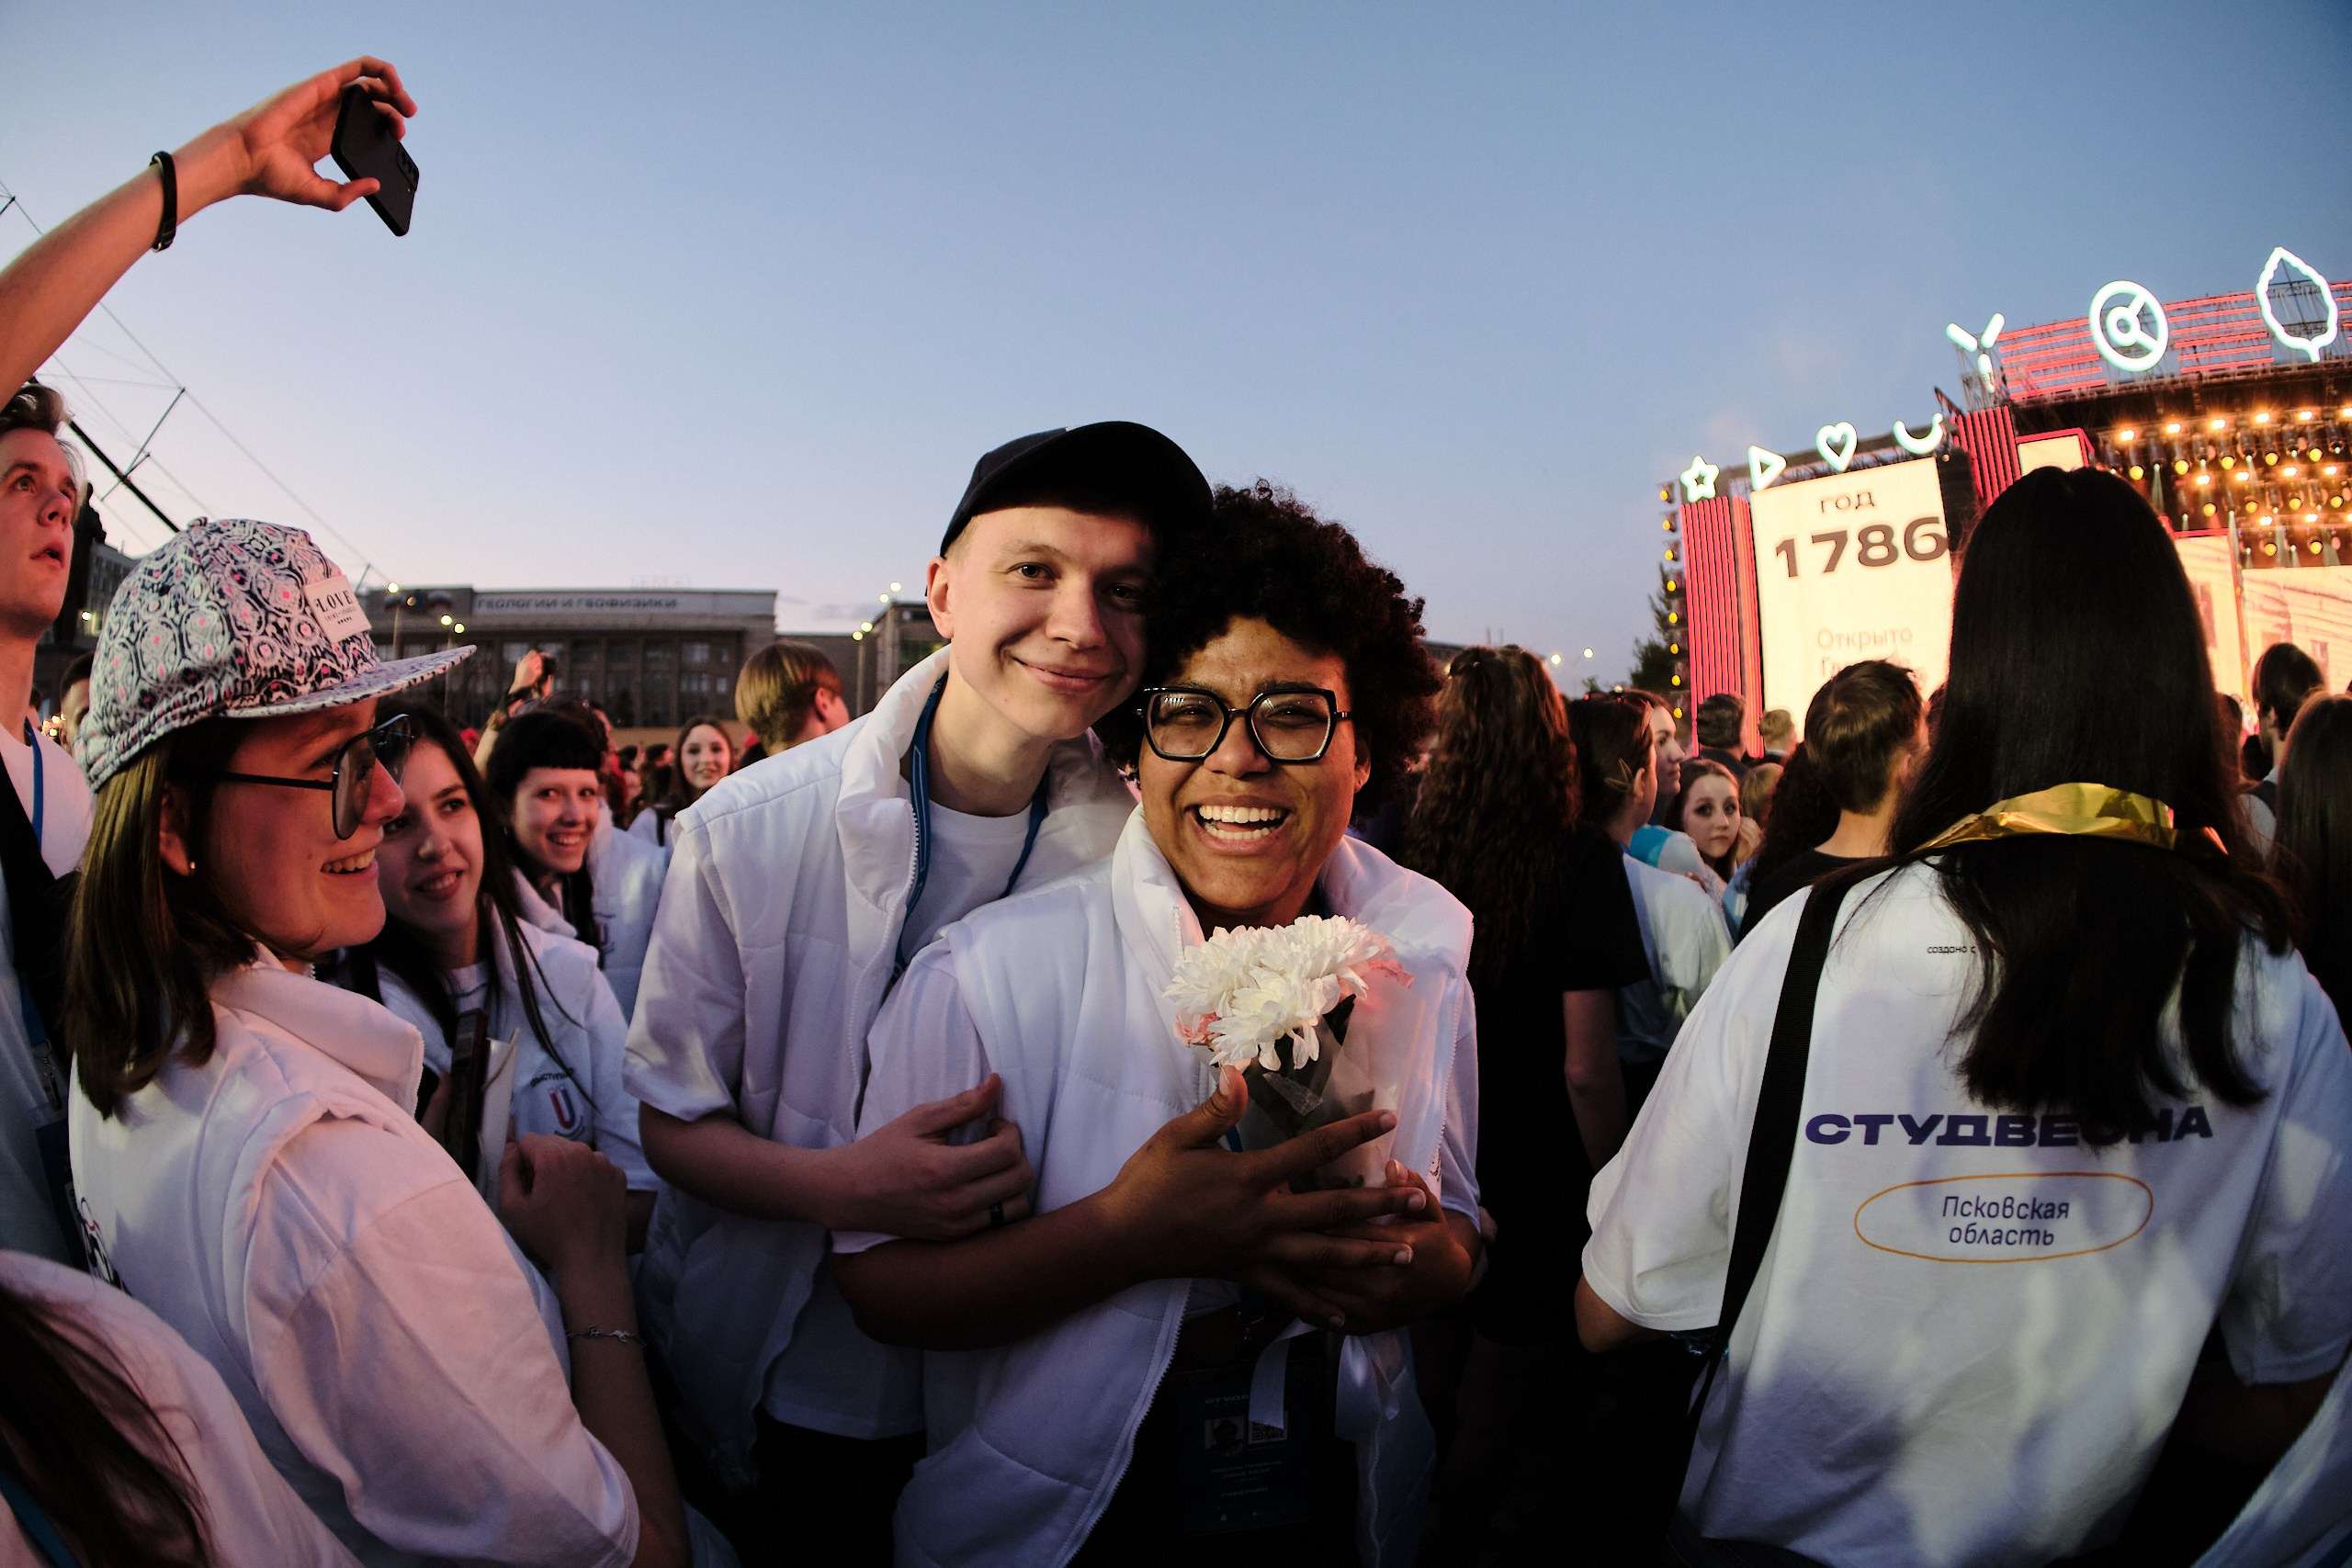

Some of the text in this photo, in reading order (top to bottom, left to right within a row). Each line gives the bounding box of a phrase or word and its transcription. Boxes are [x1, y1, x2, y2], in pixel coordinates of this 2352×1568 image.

[1775, 516, 1948, 579] 1786
[314, 590, 353, 613] LOVE
[477, 598, 677, 610] ГЕОЛОГИИ И ГЕОФИЗИКИ
[1818, 626, 1913, 652] Открыто
[1927, 945, 1967, 954] создано
[1942, 1196, 2070, 1220] Псковская
[1949, 1224, 2054, 1247] область
